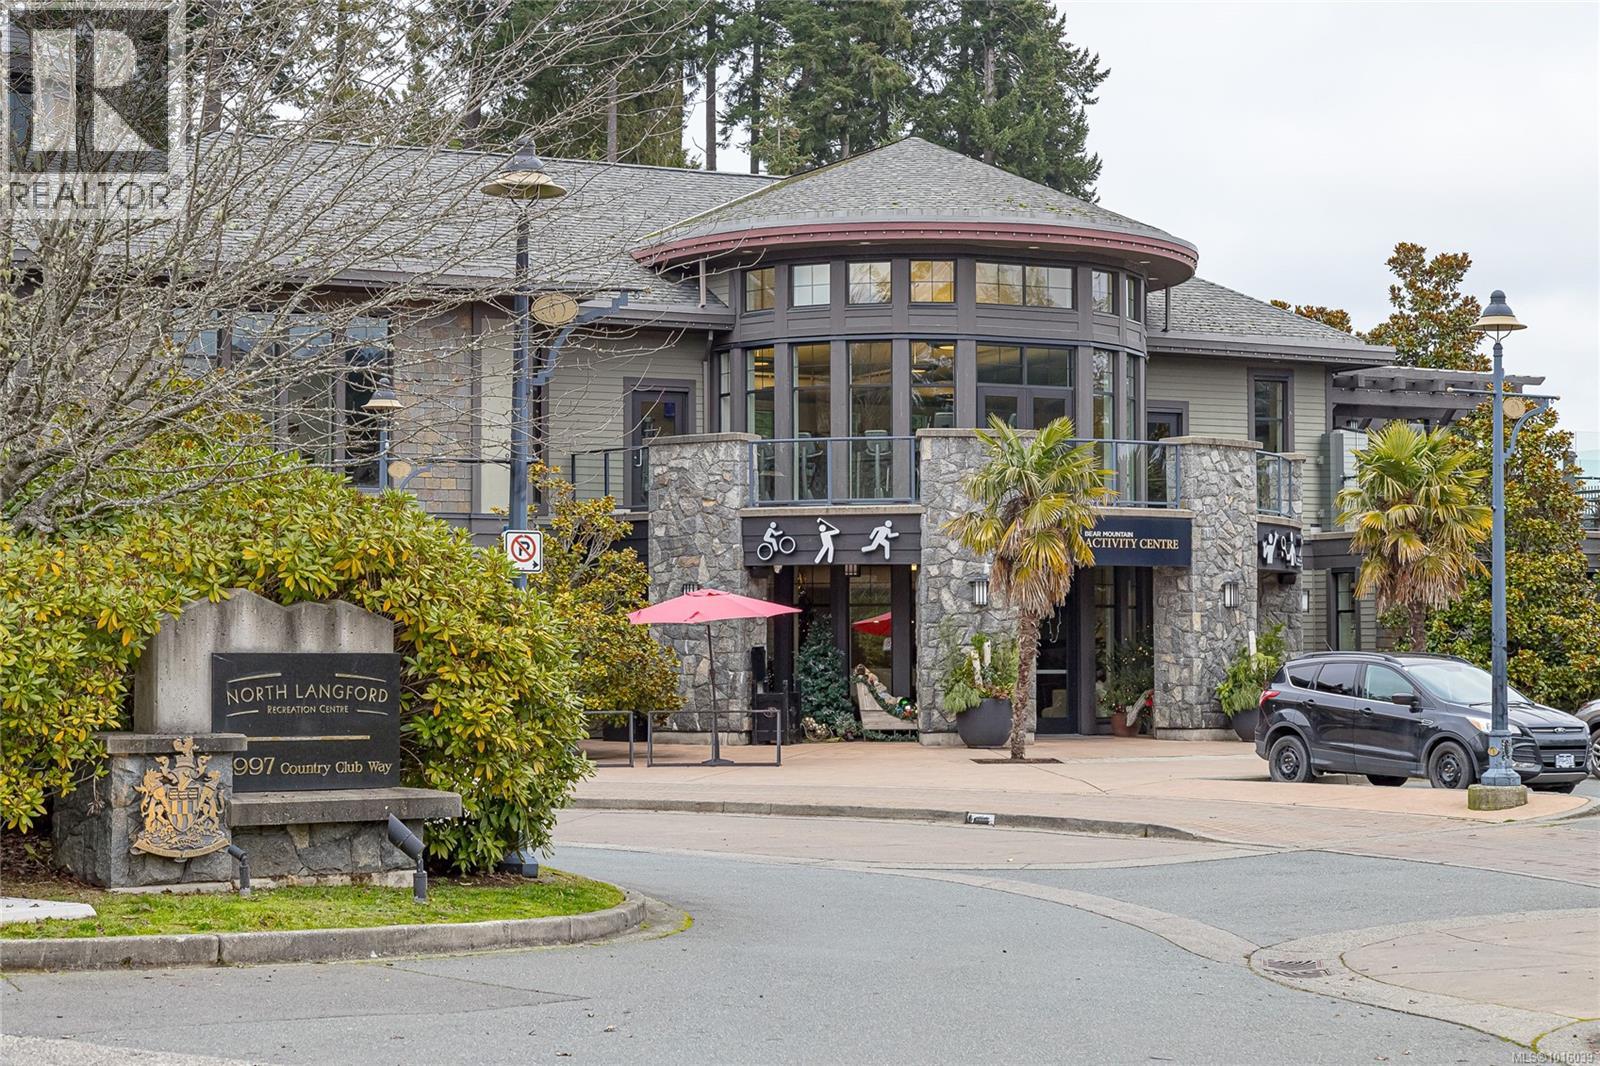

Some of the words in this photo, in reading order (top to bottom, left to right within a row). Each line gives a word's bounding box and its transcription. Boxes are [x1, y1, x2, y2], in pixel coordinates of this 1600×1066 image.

[1085, 538, 1137, 549] ACTIVITY
[1139, 539, 1179, 550] CENTRE
[226, 684, 288, 706] NORTH
[295, 683, 389, 703] LANGFORD
[280, 762, 331, 776] Country
[335, 761, 364, 774] Club
[368, 760, 393, 775] Way
